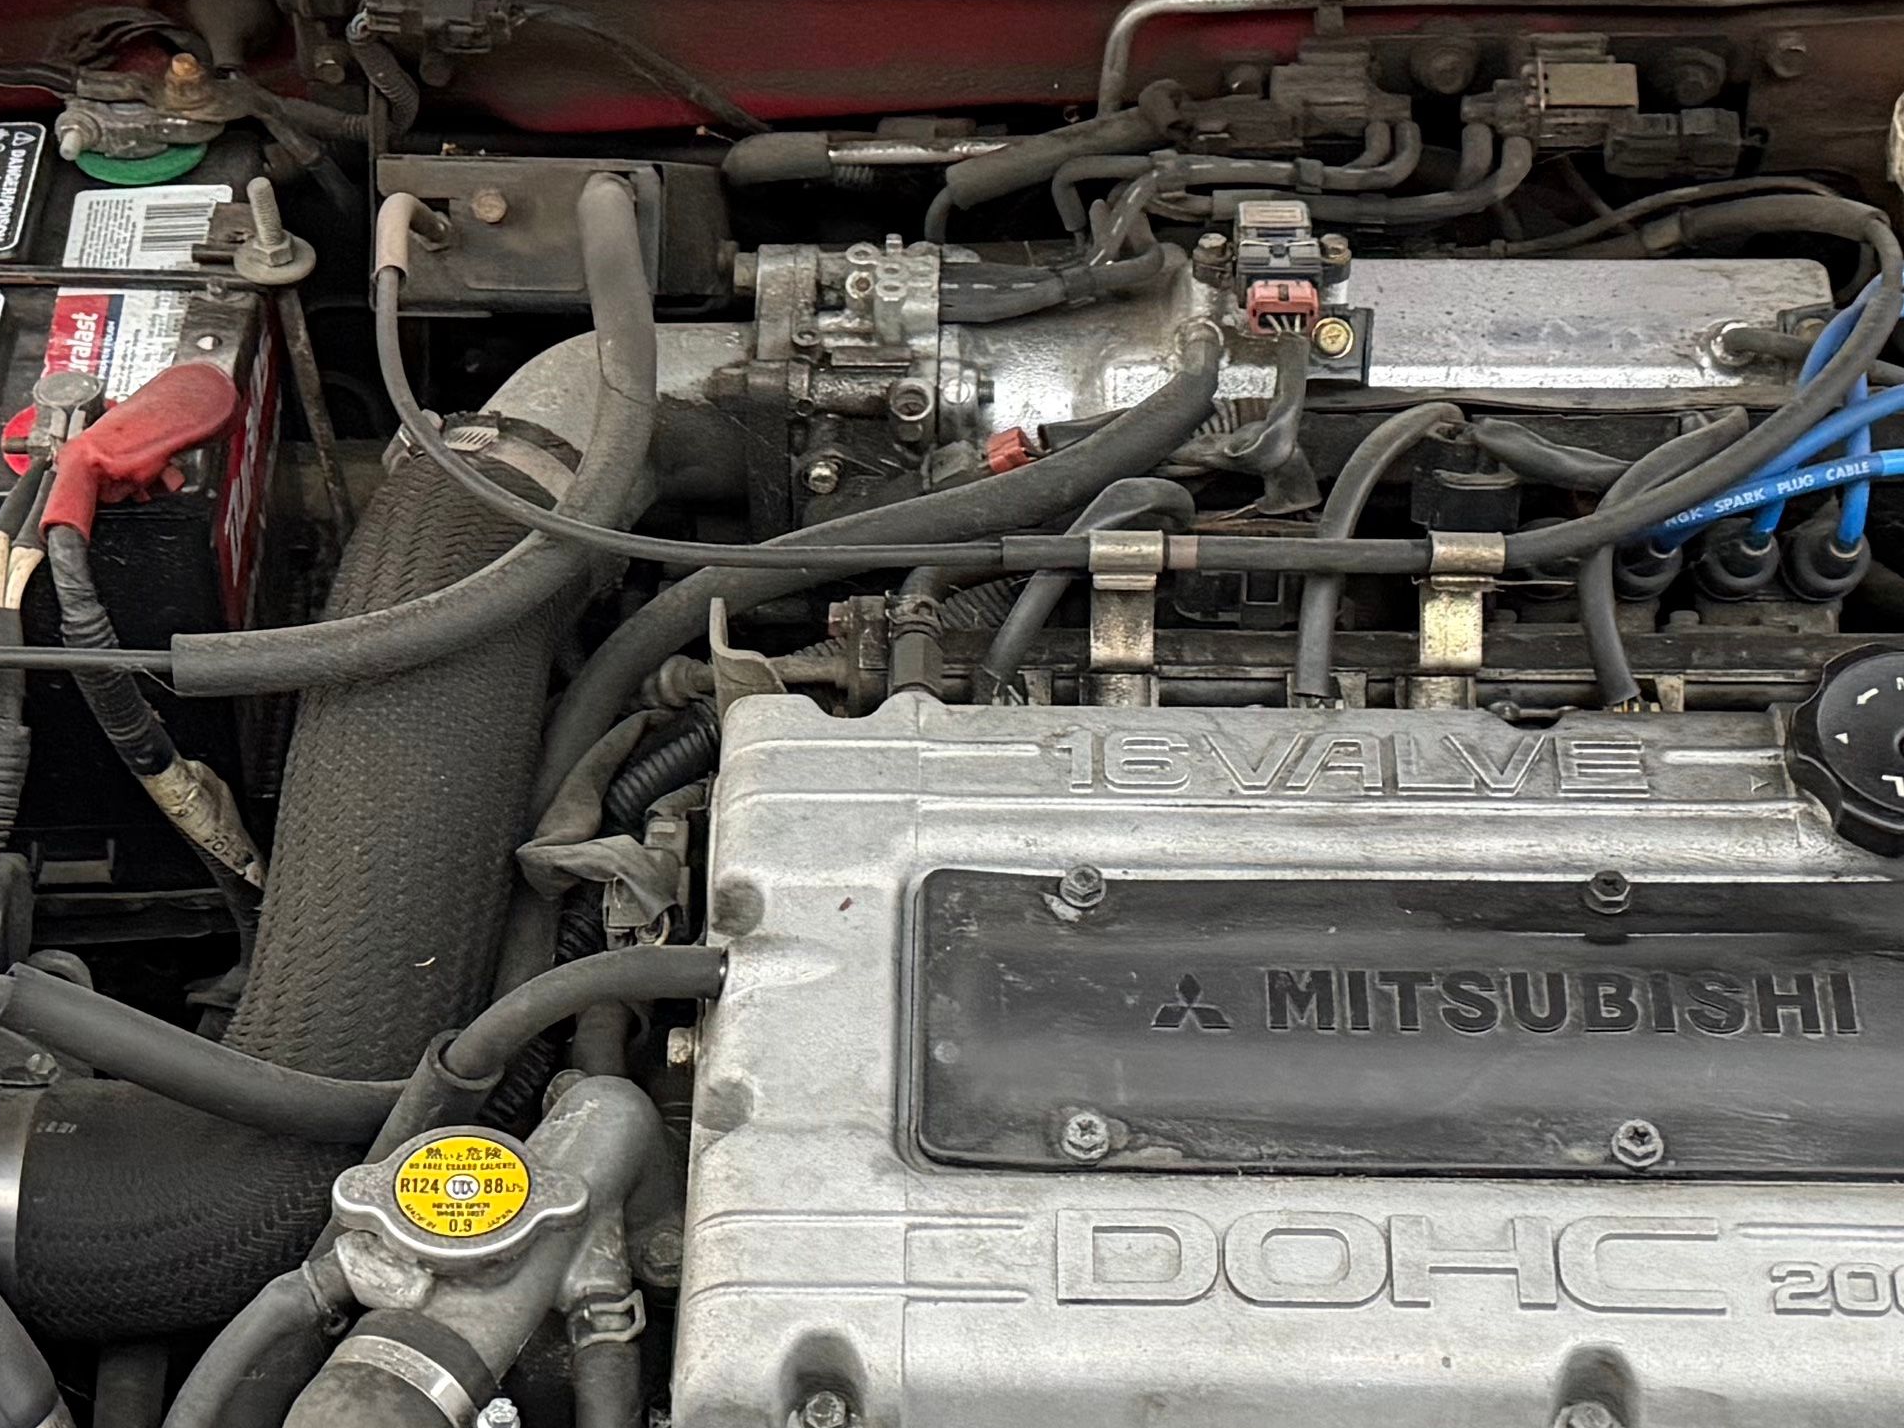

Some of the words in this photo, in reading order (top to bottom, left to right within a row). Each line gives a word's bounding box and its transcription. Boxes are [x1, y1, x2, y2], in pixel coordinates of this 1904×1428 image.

[1665, 503, 1704, 529] NGK
[1714, 487, 1766, 515] SPARK
[1776, 473, 1816, 496] PLUG
[1826, 458, 1871, 484] CABLE
[1264, 966, 1861, 1038] MITSUBISHI
[425, 1146, 503, 1162] 熱いと危険
[399, 1177, 440, 1195] R124
[448, 1218, 473, 1233] 0.9
[1053, 1207, 1729, 1317] DOHC
